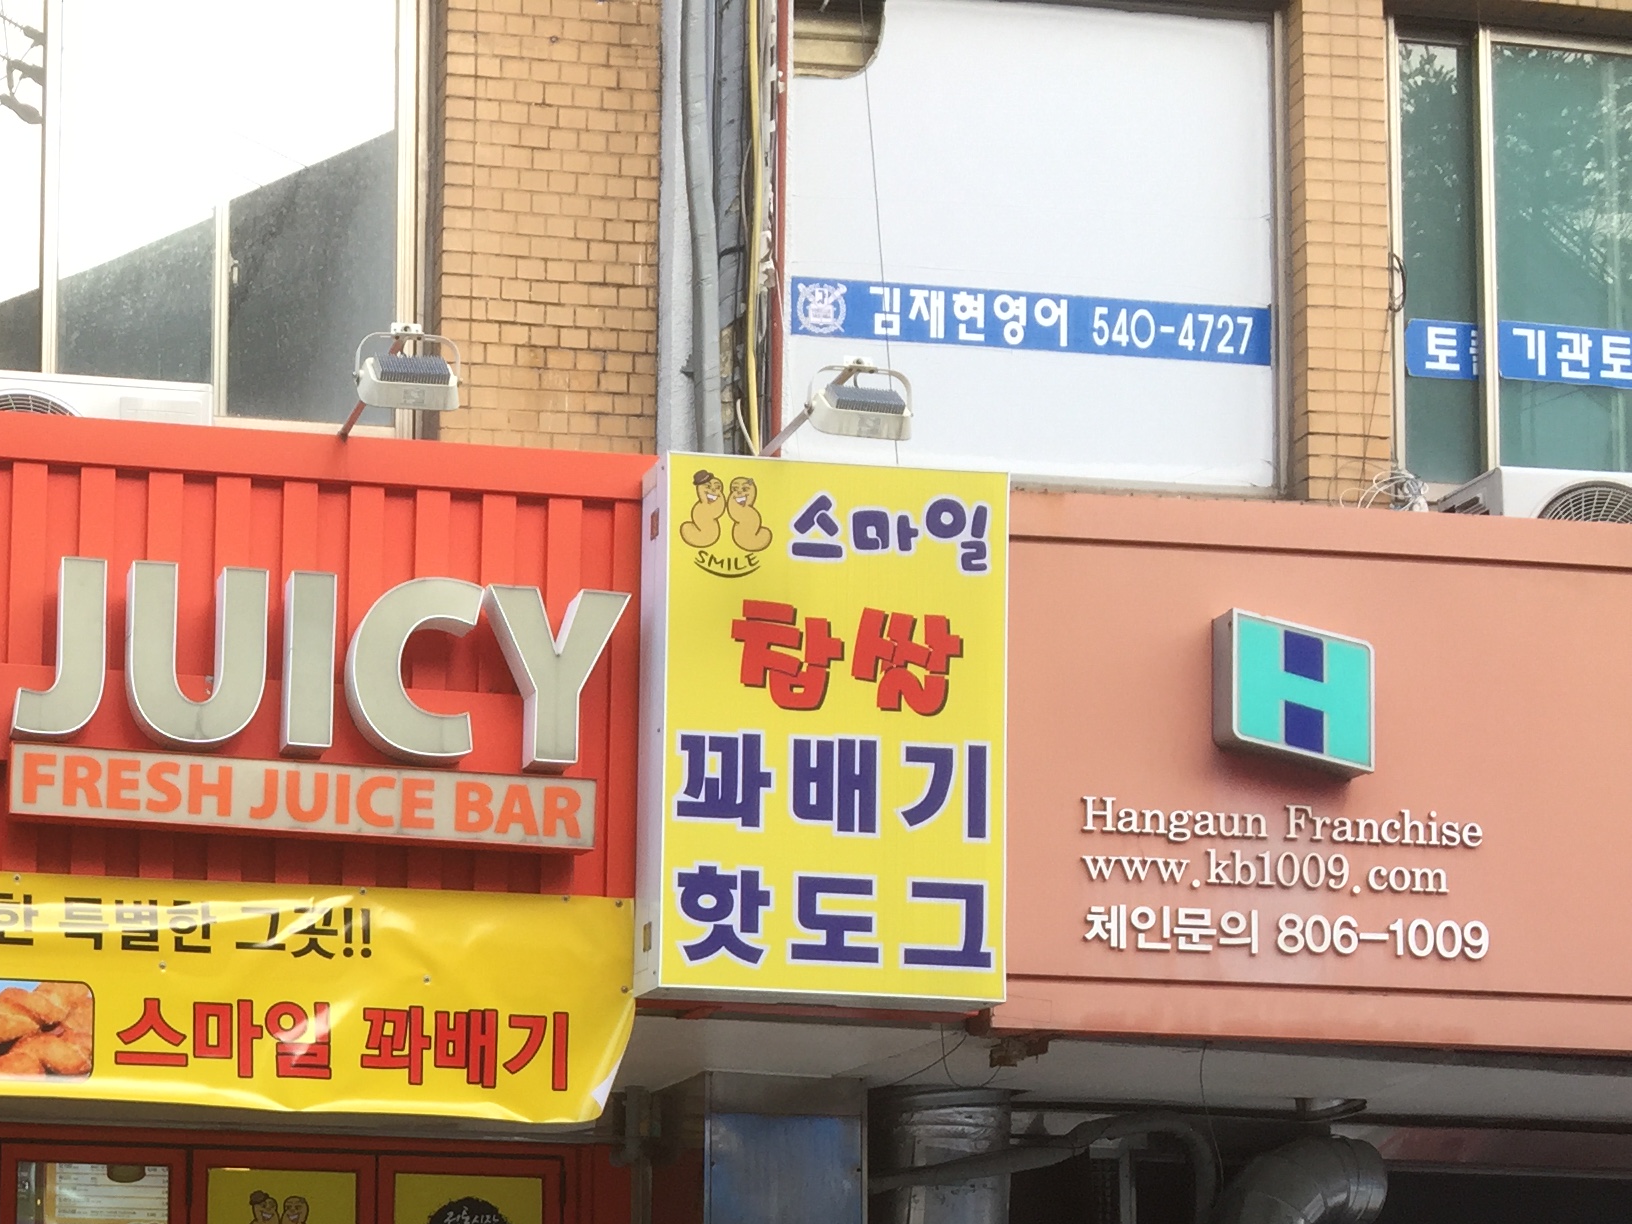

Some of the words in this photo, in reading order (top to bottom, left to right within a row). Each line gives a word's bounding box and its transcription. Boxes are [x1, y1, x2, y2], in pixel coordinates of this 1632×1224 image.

[869, 284, 1069, 347] 김재현영어
[1092, 307, 1253, 355] 540-4727
[694, 550, 760, 572] SMILE
[789, 494, 991, 574] 스마일
[10, 556, 632, 772] JUICY
[730, 598, 964, 717] 찹쌀
[21, 752, 232, 818] FRESH
[249, 769, 436, 831] JUICE
[454, 779, 582, 839] BAR
[675, 731, 991, 839] 꽈배기
[1081, 796, 1269, 843] Hangaun
[1284, 804, 1484, 848] Franchise
[1081, 848, 1450, 895] www.kb1009.com
[58, 897, 217, 954] 특별한
[676, 864, 992, 968] 핫도그
[1084, 903, 1259, 956] 체인문의
[1277, 913, 1490, 961] 806-1009
[114, 997, 333, 1081] 스마일
[360, 1005, 570, 1092] 꽈배기
